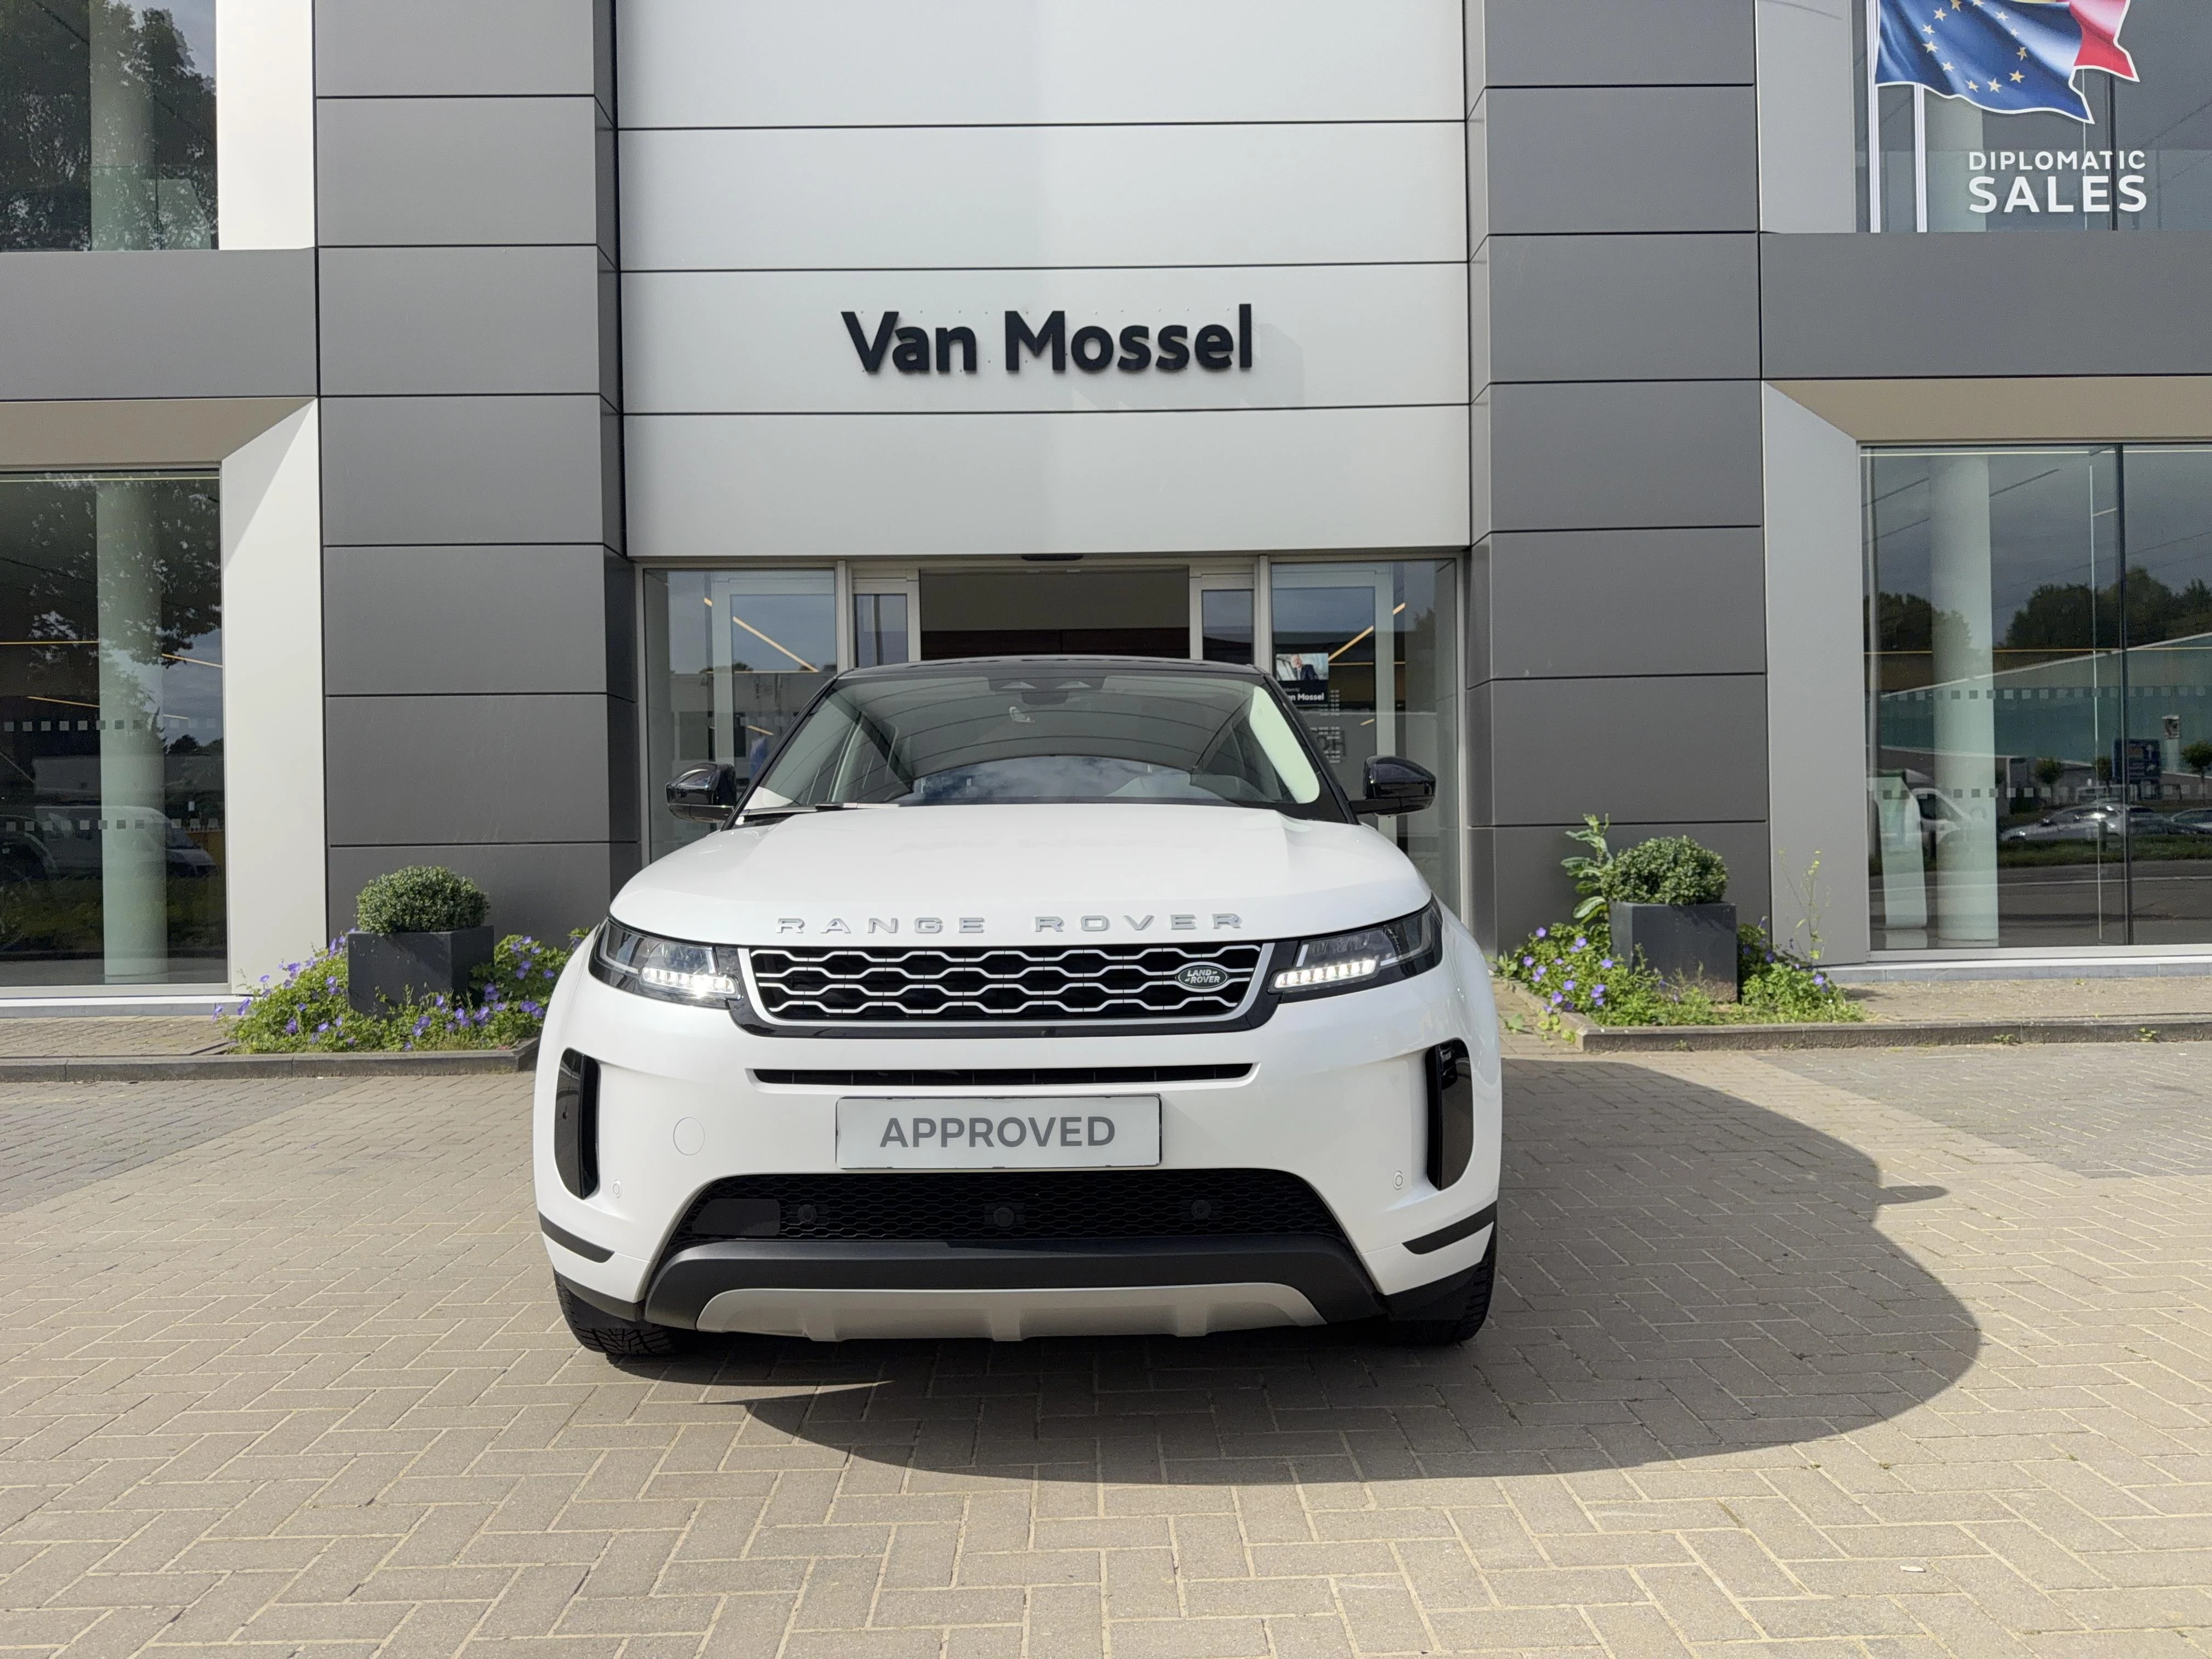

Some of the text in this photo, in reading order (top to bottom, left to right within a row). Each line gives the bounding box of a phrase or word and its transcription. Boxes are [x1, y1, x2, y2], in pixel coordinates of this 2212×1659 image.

[1968, 150, 2146, 171] DIPLOMATIC
[1968, 174, 2147, 213] SALES
[840, 303, 1252, 372] Van Mossel
[1297, 692, 1324, 701] Mossel
[776, 913, 1241, 934] RANGE ROVER
[1190, 976, 1221, 984] ROVER
[879, 1116, 1116, 1148] APPROVED
